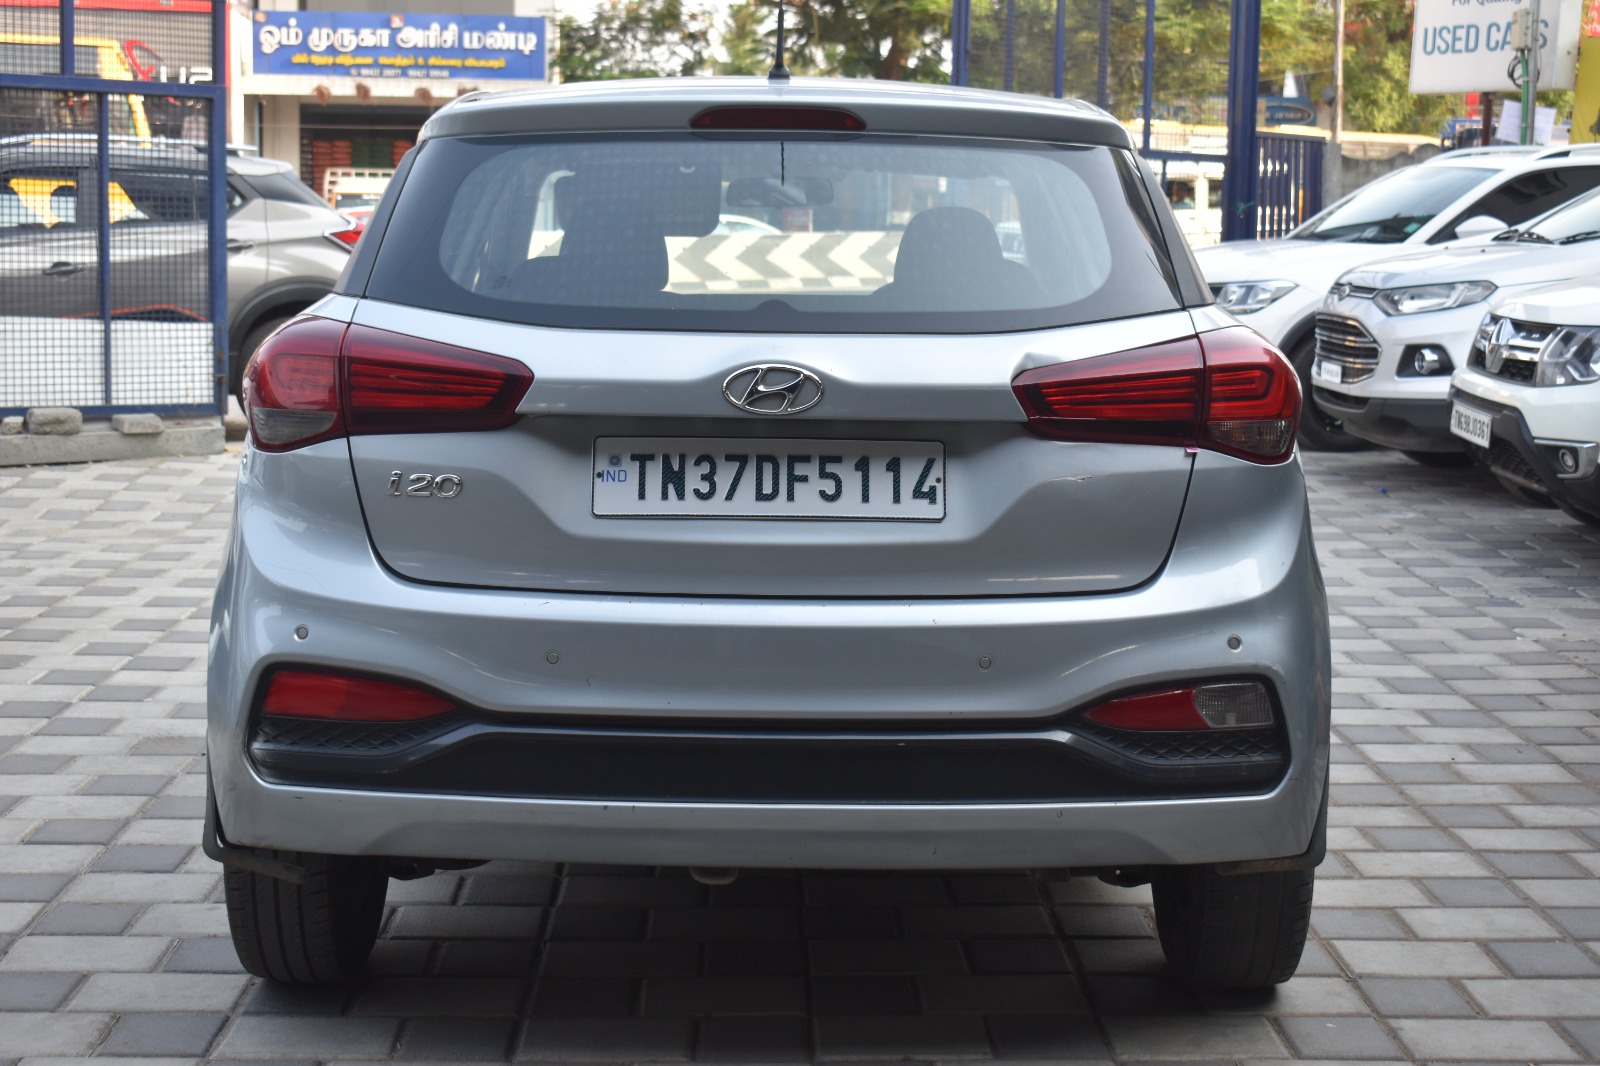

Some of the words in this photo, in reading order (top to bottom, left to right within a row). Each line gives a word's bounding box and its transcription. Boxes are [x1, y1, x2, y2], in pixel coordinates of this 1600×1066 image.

[259, 17, 303, 54] ஓம்
[307, 27, 391, 53] முருகா
[396, 22, 459, 49] அரிசி
[463, 22, 537, 55] மண்டி
[1423, 24, 1480, 56] USED
[1486, 19, 1549, 52] CAS
[388, 470, 463, 498] i20
[601, 469, 628, 483] IND
[629, 453, 938, 505] TN37DF5114
